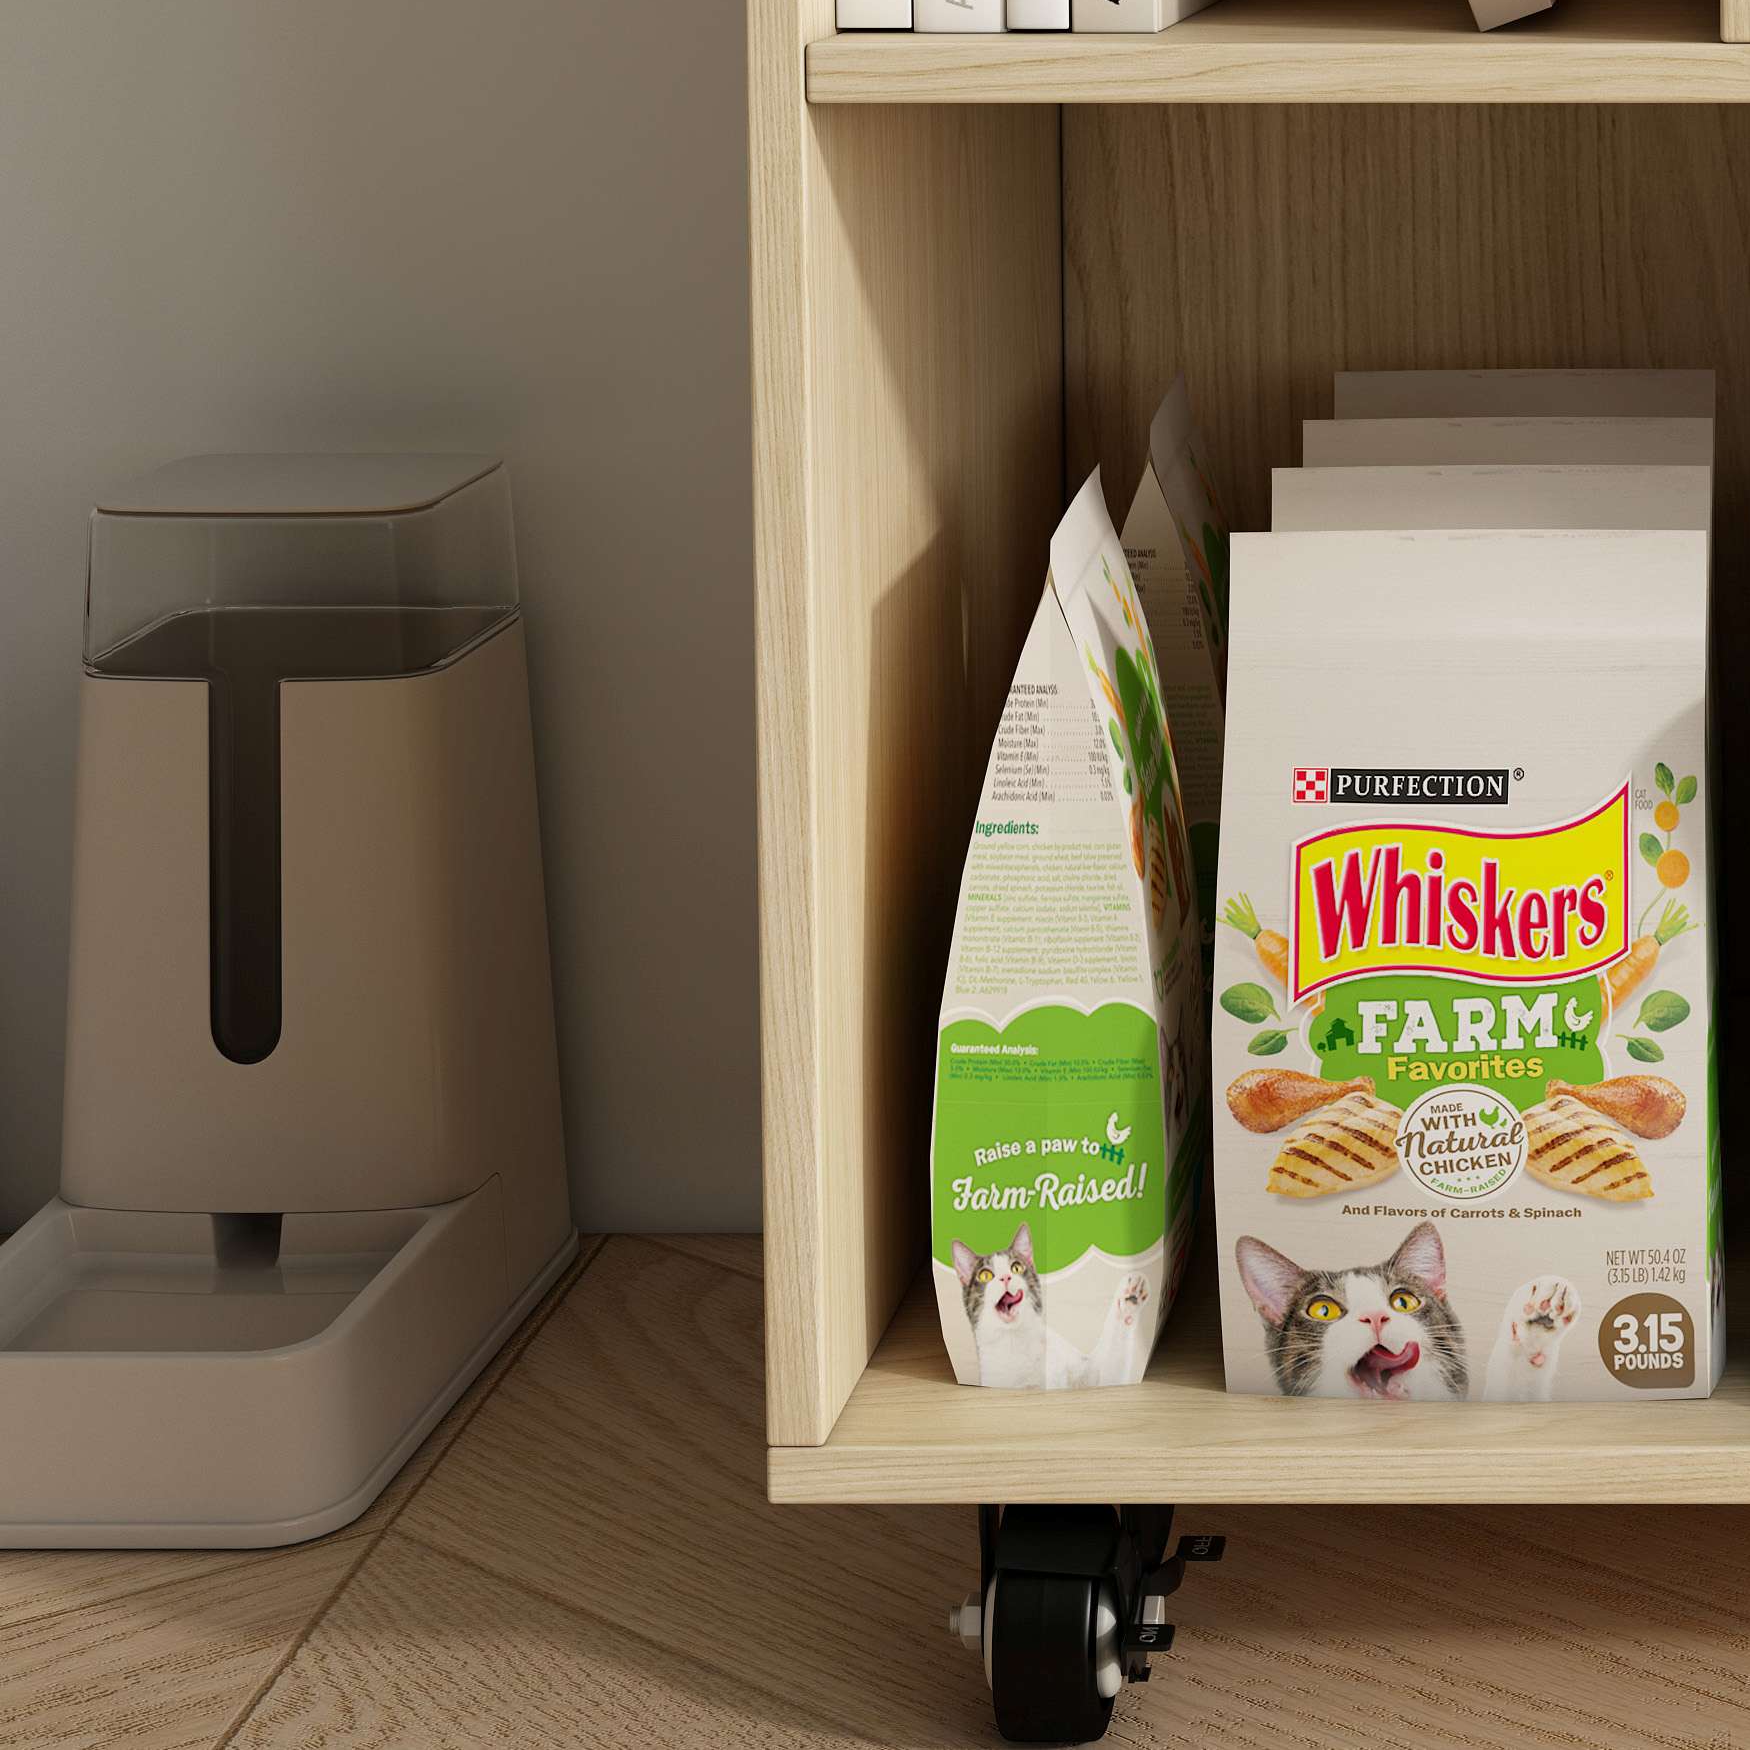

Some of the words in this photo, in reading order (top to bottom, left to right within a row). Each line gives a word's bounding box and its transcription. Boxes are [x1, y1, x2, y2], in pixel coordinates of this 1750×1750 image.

[1337, 775, 1504, 798] PURFECTION
[1634, 789, 1647, 799] CAT
[1634, 800, 1653, 810] FOOD
[975, 820, 1039, 837] Ingredients:
[1312, 844, 1607, 959] Whiskers
[1357, 993, 1559, 1055] FARM
[951, 1043, 1000, 1055] Guaranteed
[1001, 1044, 1039, 1057] Analysis:
[1388, 1055, 1544, 1081] Favorites
[1430, 1103, 1464, 1114] MADE
[1420, 1112, 1477, 1131] WITH
[1395, 1121, 1524, 1159] Natural
[974, 1140, 1022, 1168] Raise
[1025, 1141, 1037, 1154] a
[1041, 1139, 1075, 1160] paw
[1080, 1136, 1100, 1156] to
[1419, 1152, 1513, 1176] CHICKEN
[951, 1162, 1149, 1212] Farm-Raised!
[1430, 1168, 1507, 1195] FARM-RAISED
[1342, 1204, 1371, 1217] And
[1374, 1204, 1427, 1219] Flavors
[1430, 1205, 1448, 1219] of
[1450, 1207, 1506, 1220] Carrots
[1508, 1208, 1521, 1220] &
[1523, 1206, 1582, 1222] Spinach
[1606, 1250, 1626, 1266] NET
[1628, 1250, 1647, 1265] WT
[1648, 1249, 1670, 1265] 50.4
[1672, 1248, 1687, 1264] OZ
[1607, 1268, 1630, 1286] (3.15
[1632, 1267, 1649, 1285] LB)
[1652, 1267, 1671, 1282] 1.42
[1673, 1266, 1686, 1284] kg
[1613, 1313, 1685, 1354] 3.15
[1614, 1353, 1684, 1371] POUNDS
